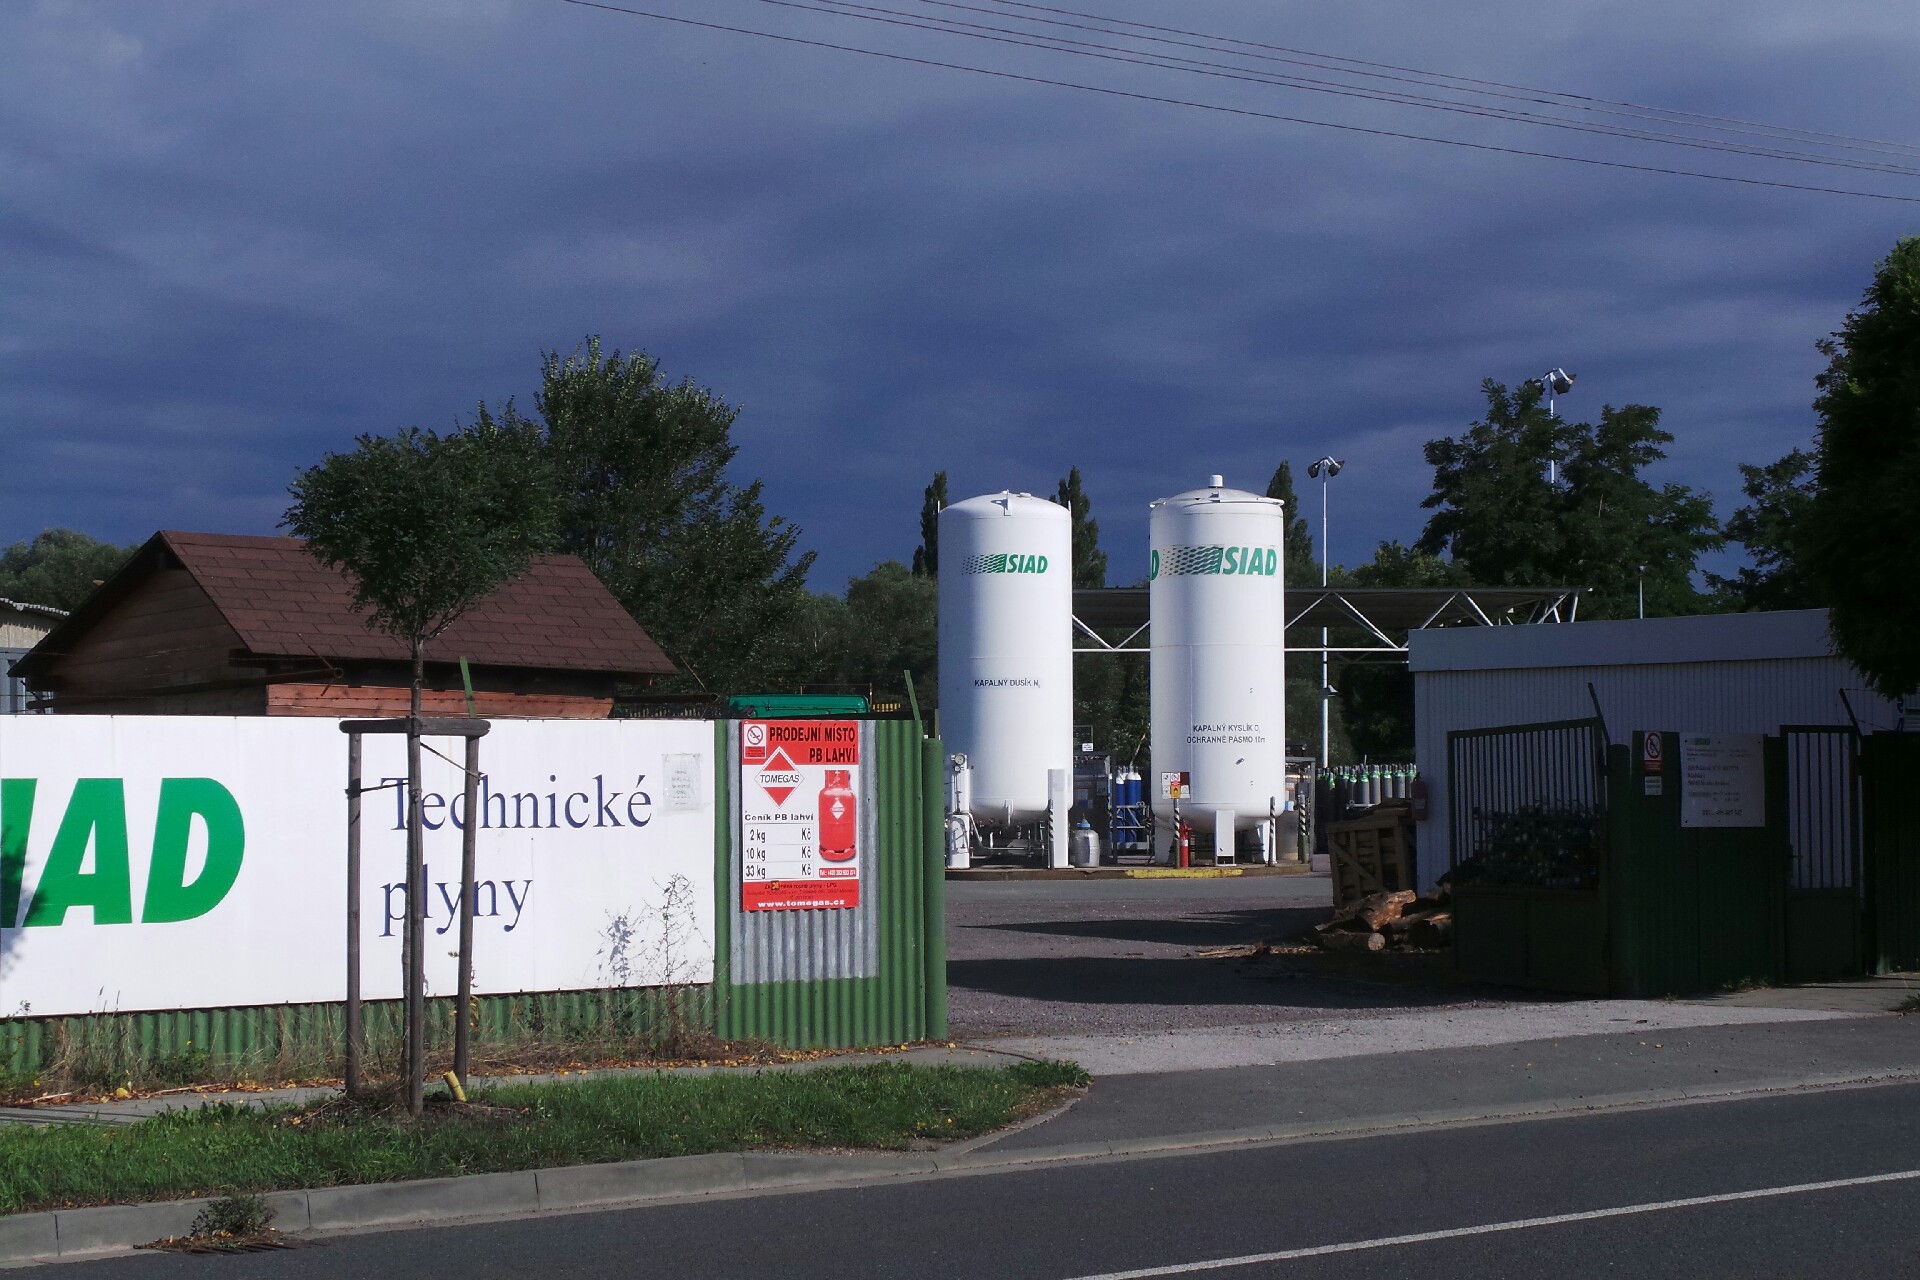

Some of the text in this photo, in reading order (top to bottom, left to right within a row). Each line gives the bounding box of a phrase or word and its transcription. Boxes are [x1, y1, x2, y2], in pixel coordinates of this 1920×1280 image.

[1007, 554, 1048, 574] SIAD
[1222, 547, 1277, 576] SIAD
[975, 678, 1008, 687] KAPALNÝ
[1010, 678, 1031, 687] DUSÍK
[769, 723, 855, 742] PRODEJNÍ MÍSTO
[1193, 723, 1226, 732] KAPALNÝ
[1229, 723, 1252, 732] KYSLÍK
[1187, 735, 1226, 743] OCHRANNÉ
[1229, 735, 1253, 743] PÁSMO
[810, 744, 855, 762] PB LAHVÍ
[760, 775, 800, 783] TOMEGAS
[380, 774, 652, 830] Technické
[750, 828, 811, 843] 2 kg Kč
[746, 846, 811, 861] 10 kg Kč
[746, 864, 811, 879] 33 kg Kč
[379, 864, 533, 937] plyny
[757, 899, 845, 907] www.tomegas.cz
